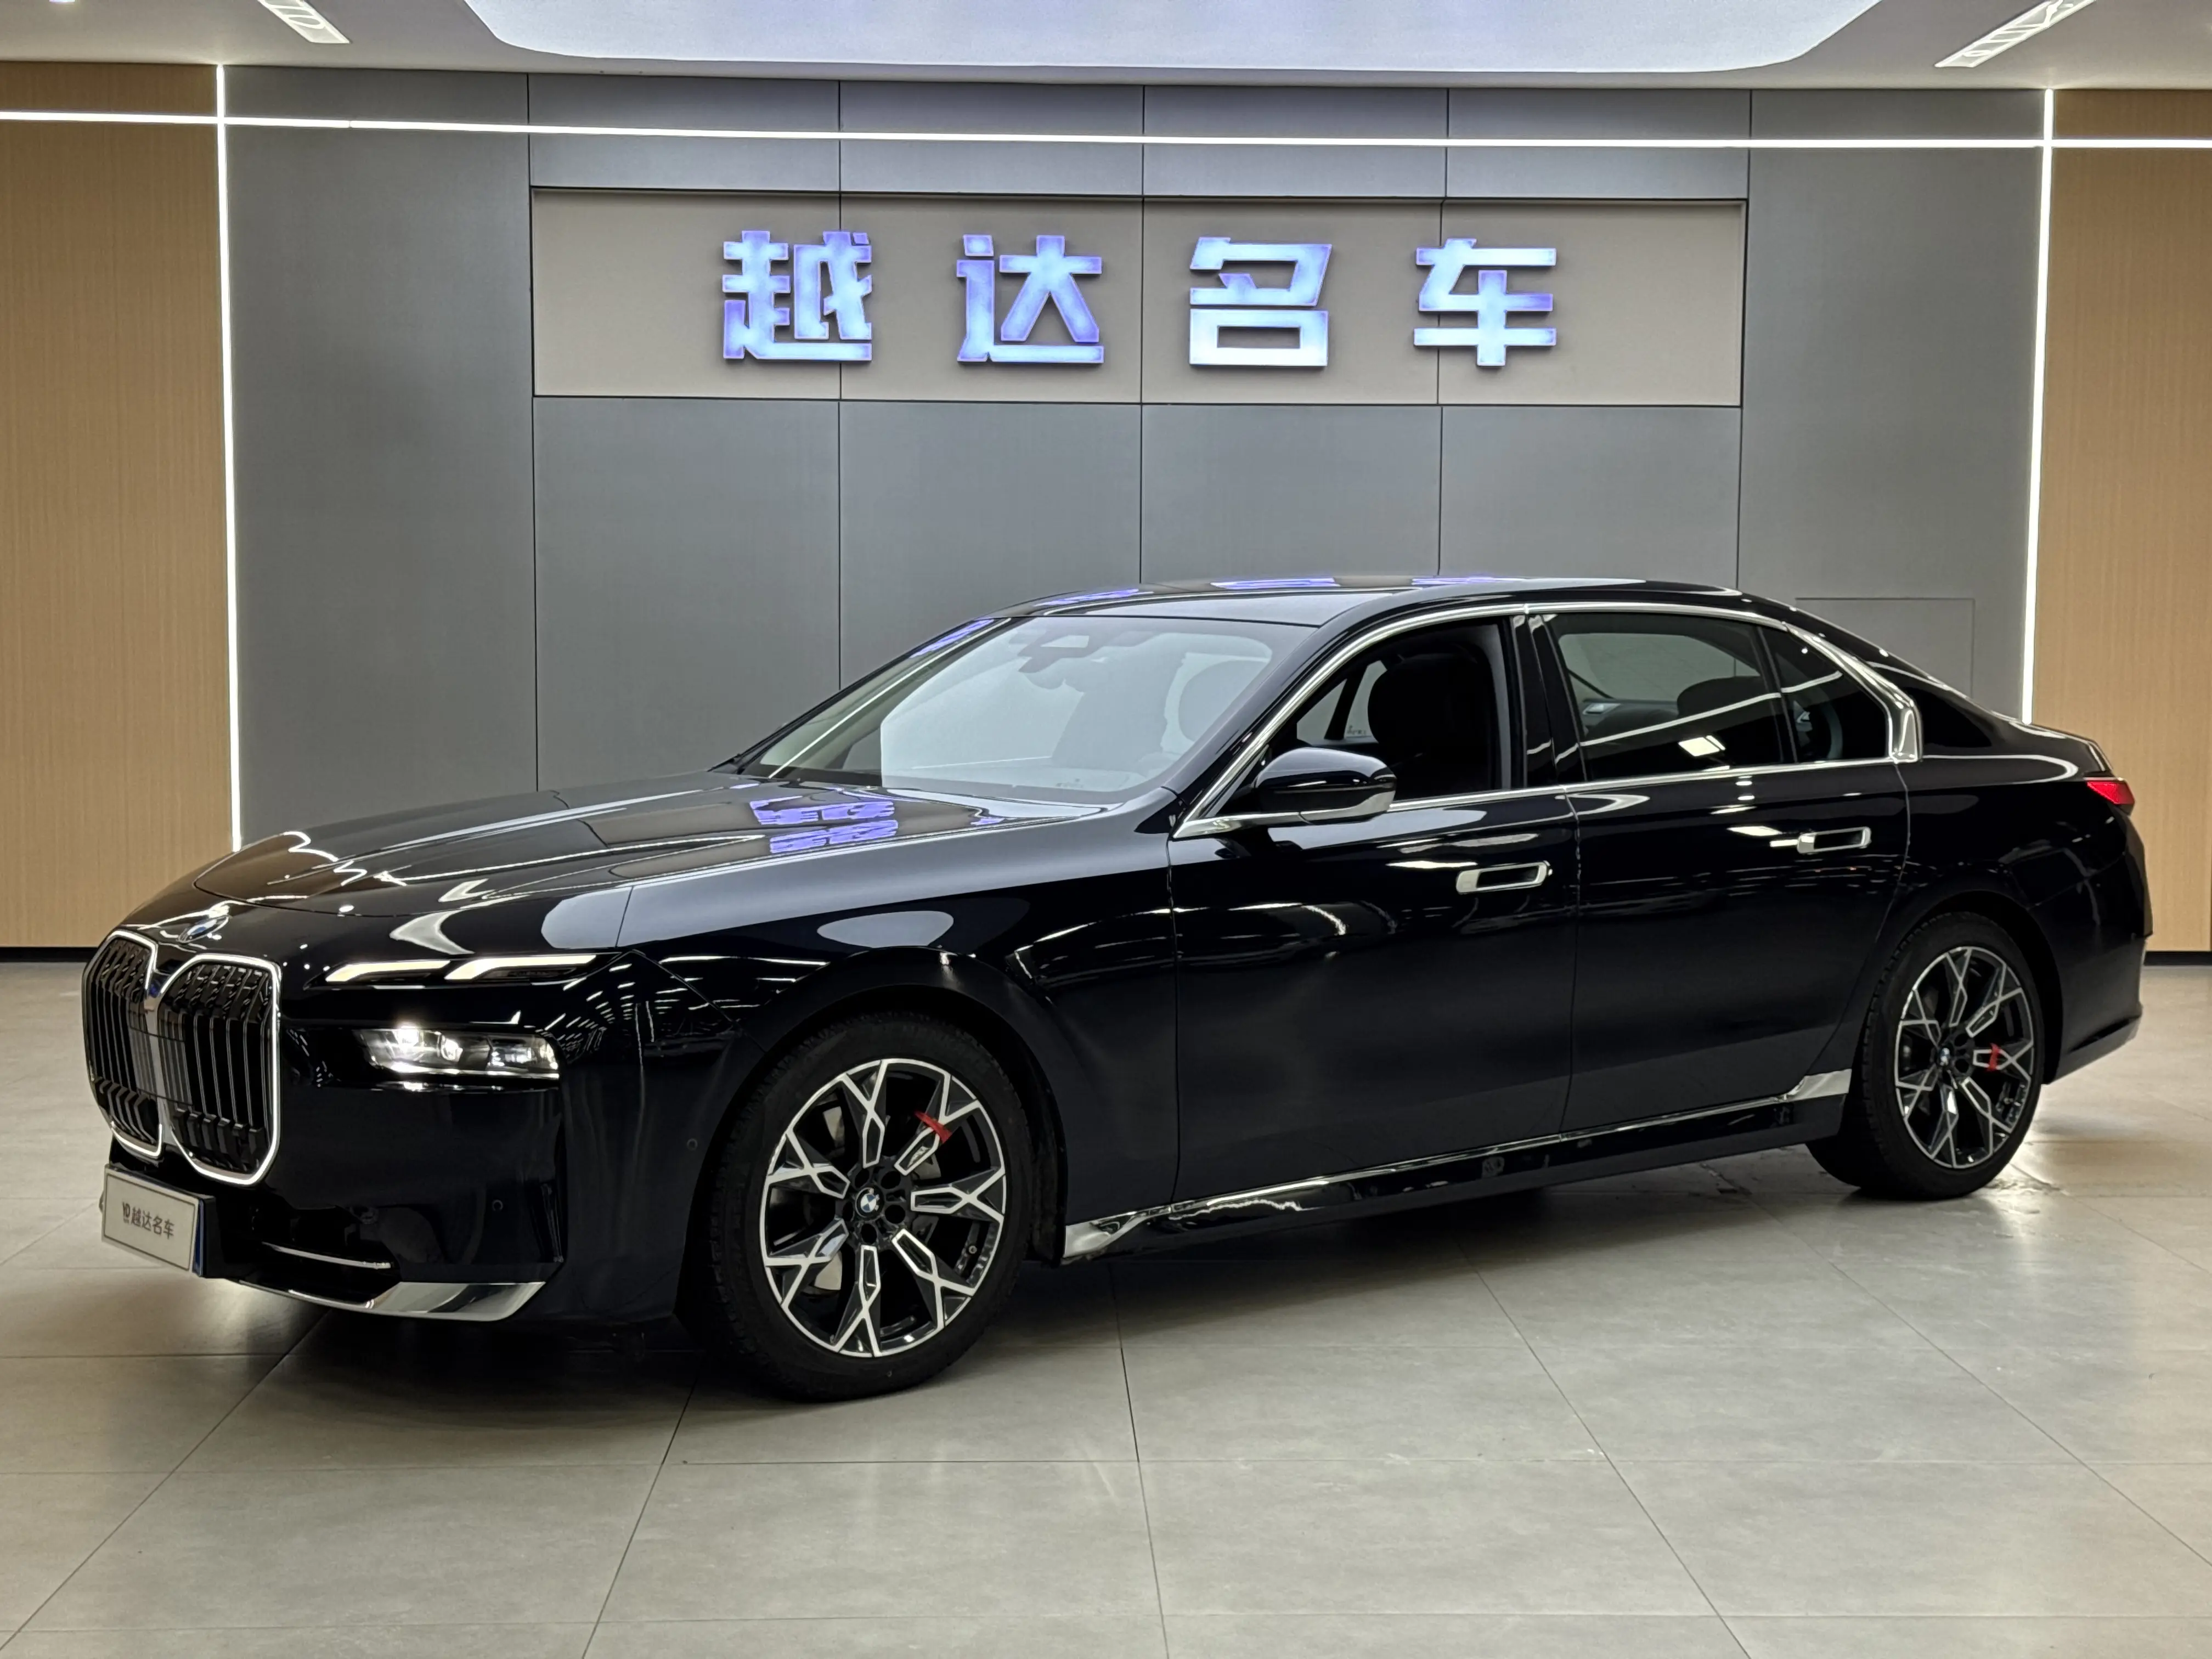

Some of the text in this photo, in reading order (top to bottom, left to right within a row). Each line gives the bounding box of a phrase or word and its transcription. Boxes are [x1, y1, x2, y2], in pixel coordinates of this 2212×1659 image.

[722, 229, 1558, 366] 越达名车
[131, 1206, 175, 1240] 越达名车
